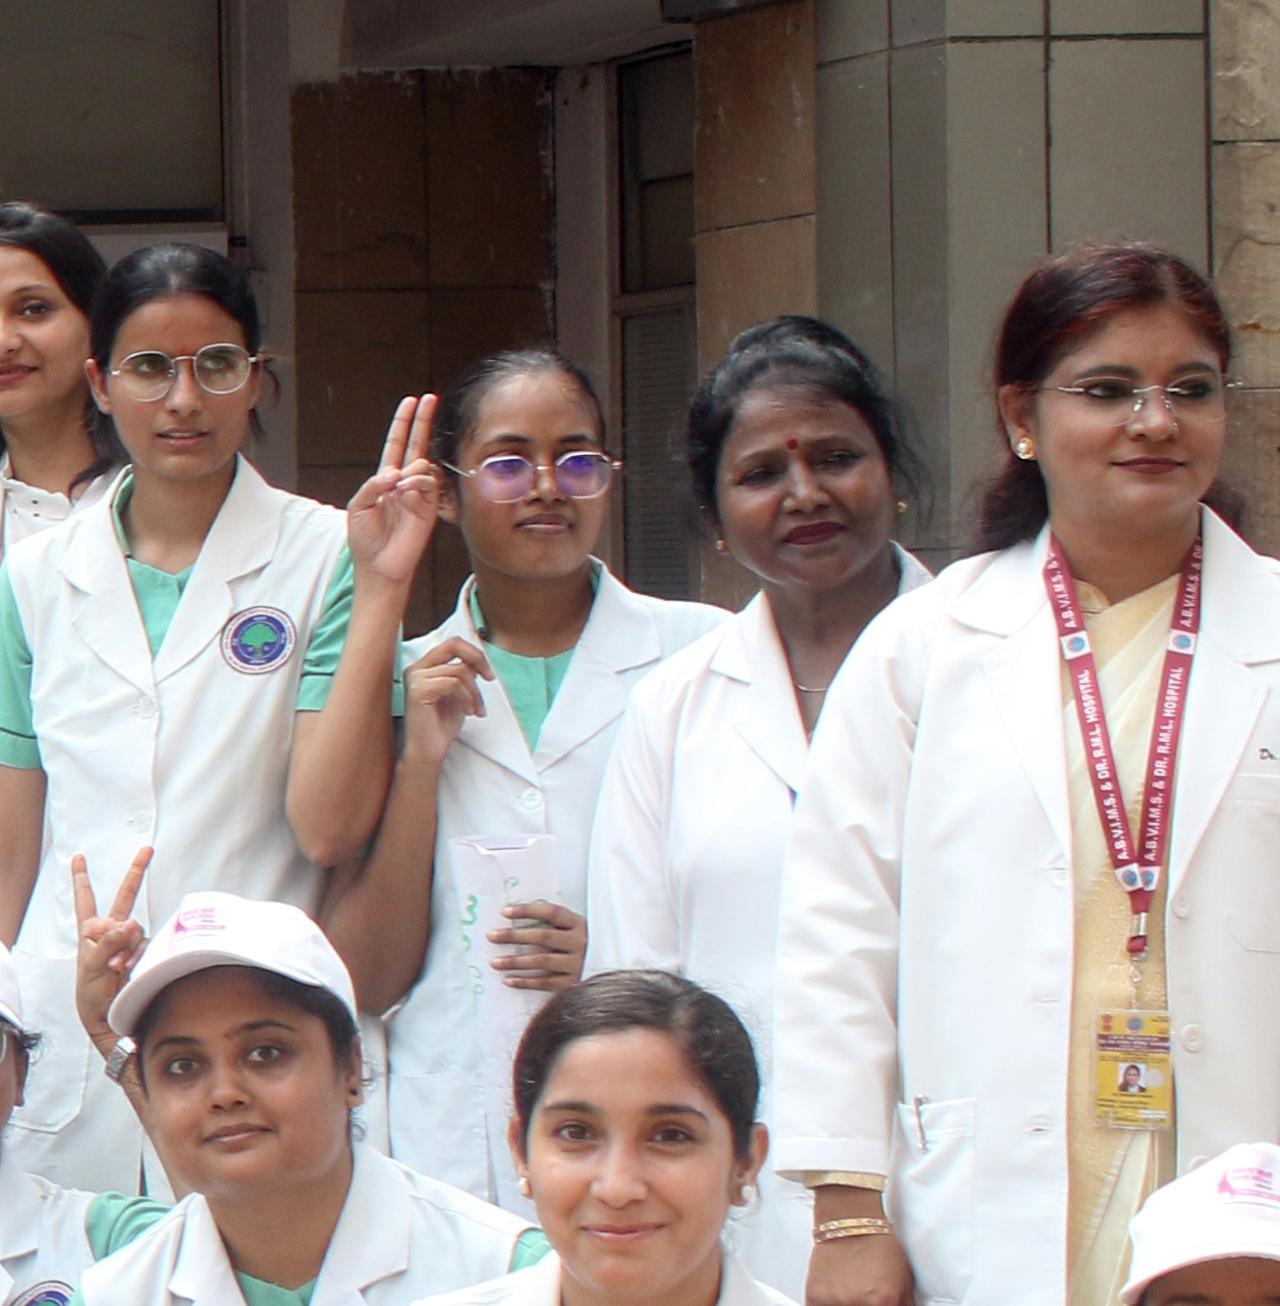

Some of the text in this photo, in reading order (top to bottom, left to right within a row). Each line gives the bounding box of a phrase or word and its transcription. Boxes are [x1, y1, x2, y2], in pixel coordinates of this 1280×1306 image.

[1077, 669, 1127, 862] A.B.V.I.M.S. & DR. R.M.L. HOSPITAL
[1144, 666, 1183, 863] A.B.V.I.M.S. & DR. R.M.L. HOSPITAL
